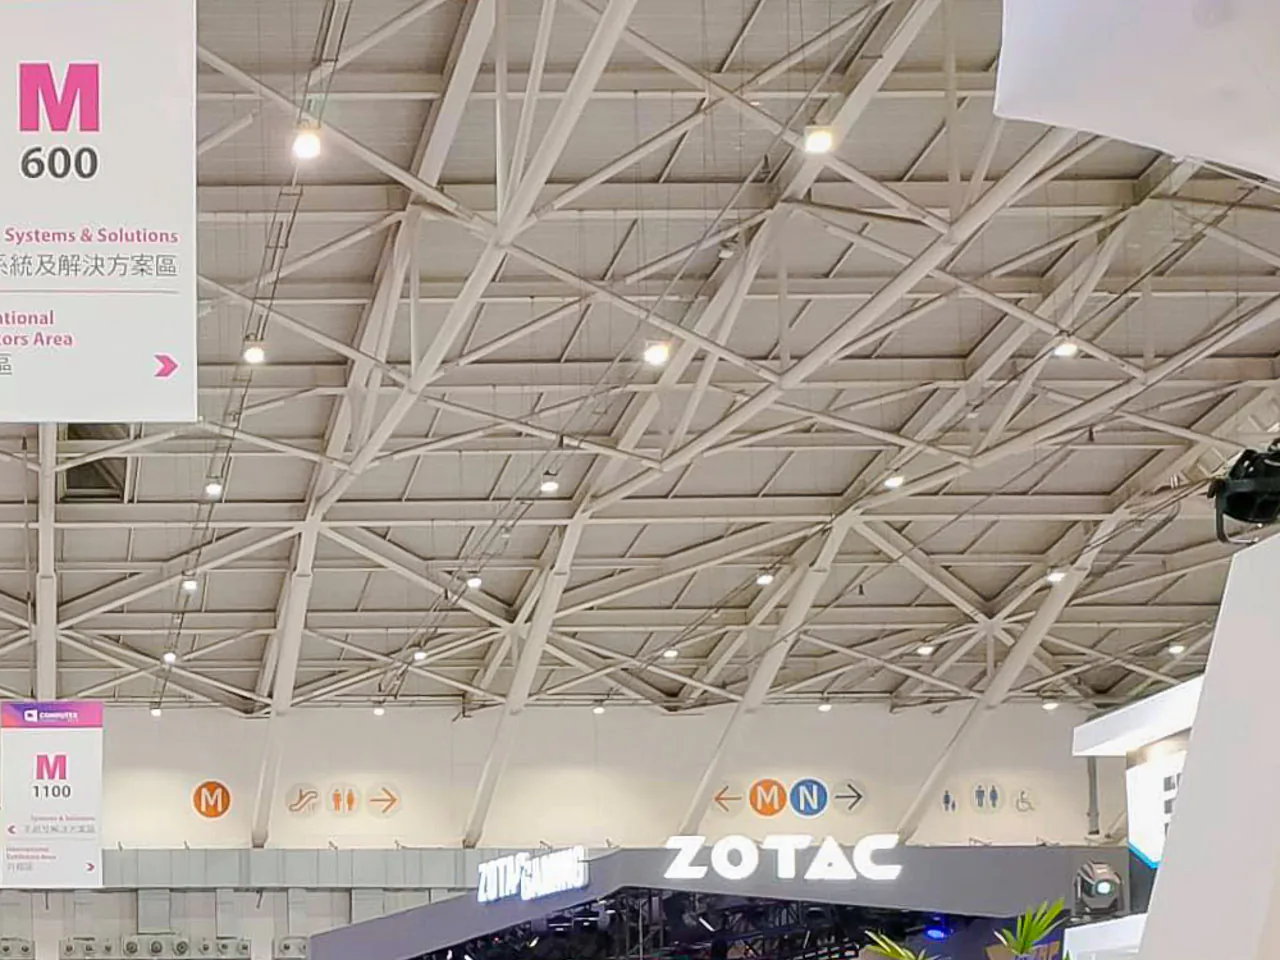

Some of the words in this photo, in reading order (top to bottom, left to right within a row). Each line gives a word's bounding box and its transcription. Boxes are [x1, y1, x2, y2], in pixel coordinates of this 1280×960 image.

[19, 63, 100, 132] M
[21, 147, 98, 179] 600
[4, 228, 75, 246] Systems
[80, 228, 93, 243] &
[98, 228, 178, 243] Solutions
[33, 332, 73, 346] Area
[36, 754, 67, 780] M
[32, 785, 71, 798] 1100
[201, 787, 222, 812] M
[756, 786, 779, 810] M
[799, 786, 819, 810] N
[664, 834, 902, 880] ZOTAC
